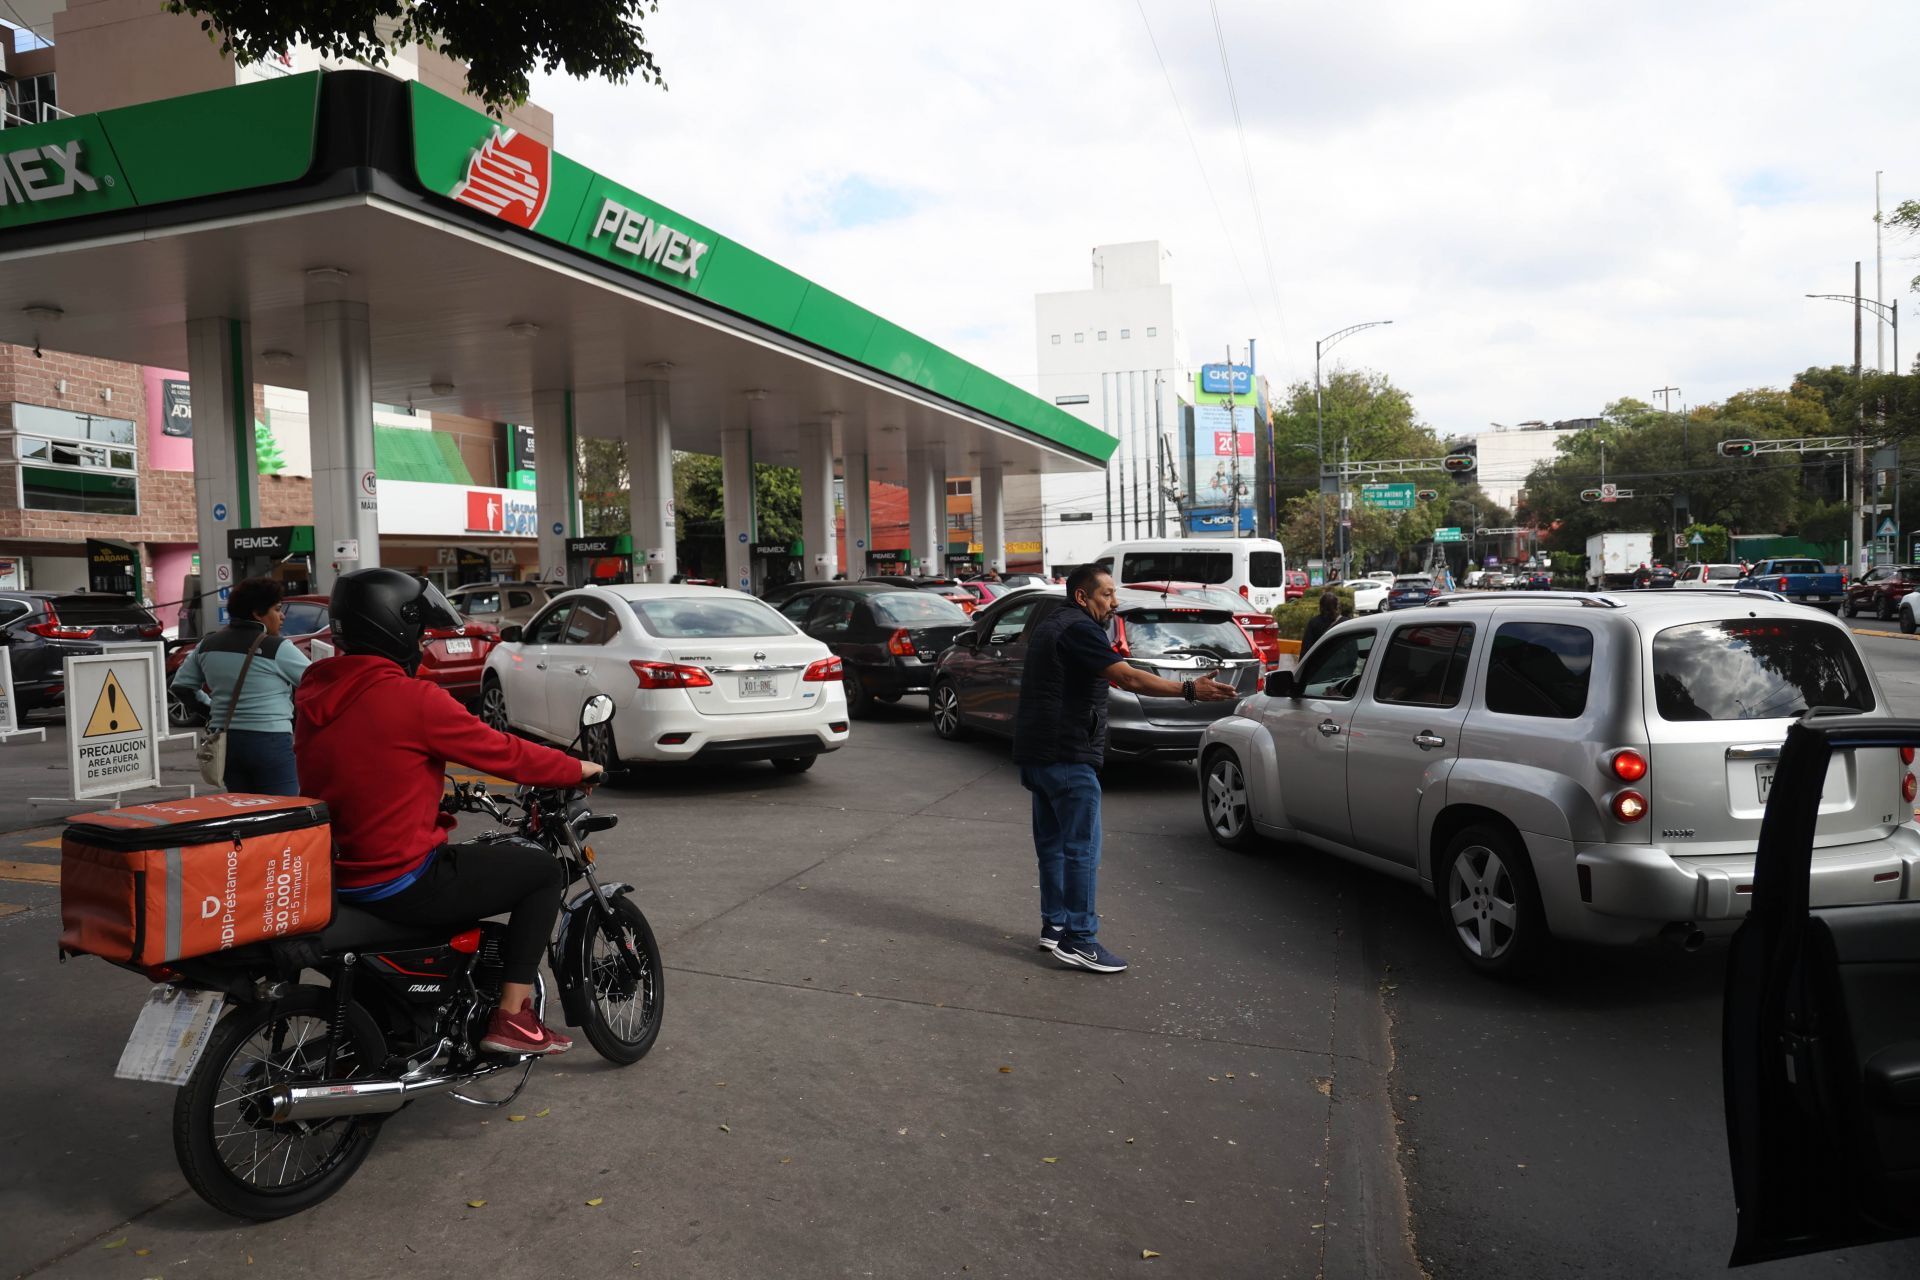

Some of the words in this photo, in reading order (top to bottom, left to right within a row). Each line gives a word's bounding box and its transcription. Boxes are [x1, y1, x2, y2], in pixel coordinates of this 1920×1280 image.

[592, 198, 709, 279] PEMEX
[234, 536, 279, 549] PEMEX
[572, 542, 606, 552] PEMEX
[757, 546, 786, 554] PEMEX
[437, 548, 516, 565] FACIA
[872, 552, 897, 560] PEMEX
[80, 740, 147, 759] PRECAUCION
[88, 757, 111, 768] AREA
[112, 753, 139, 764] FUERA
[87, 769, 99, 779] DE
[101, 762, 140, 776] SERVICIO
[264, 860, 276, 890] hasta
[292, 856, 302, 898] minutos
[222, 851, 238, 923] Préstamos
[263, 892, 275, 933] Solicita
[291, 901, 300, 909] 5
[292, 911, 299, 925] en
[408, 984, 438, 992] ITALIKA
